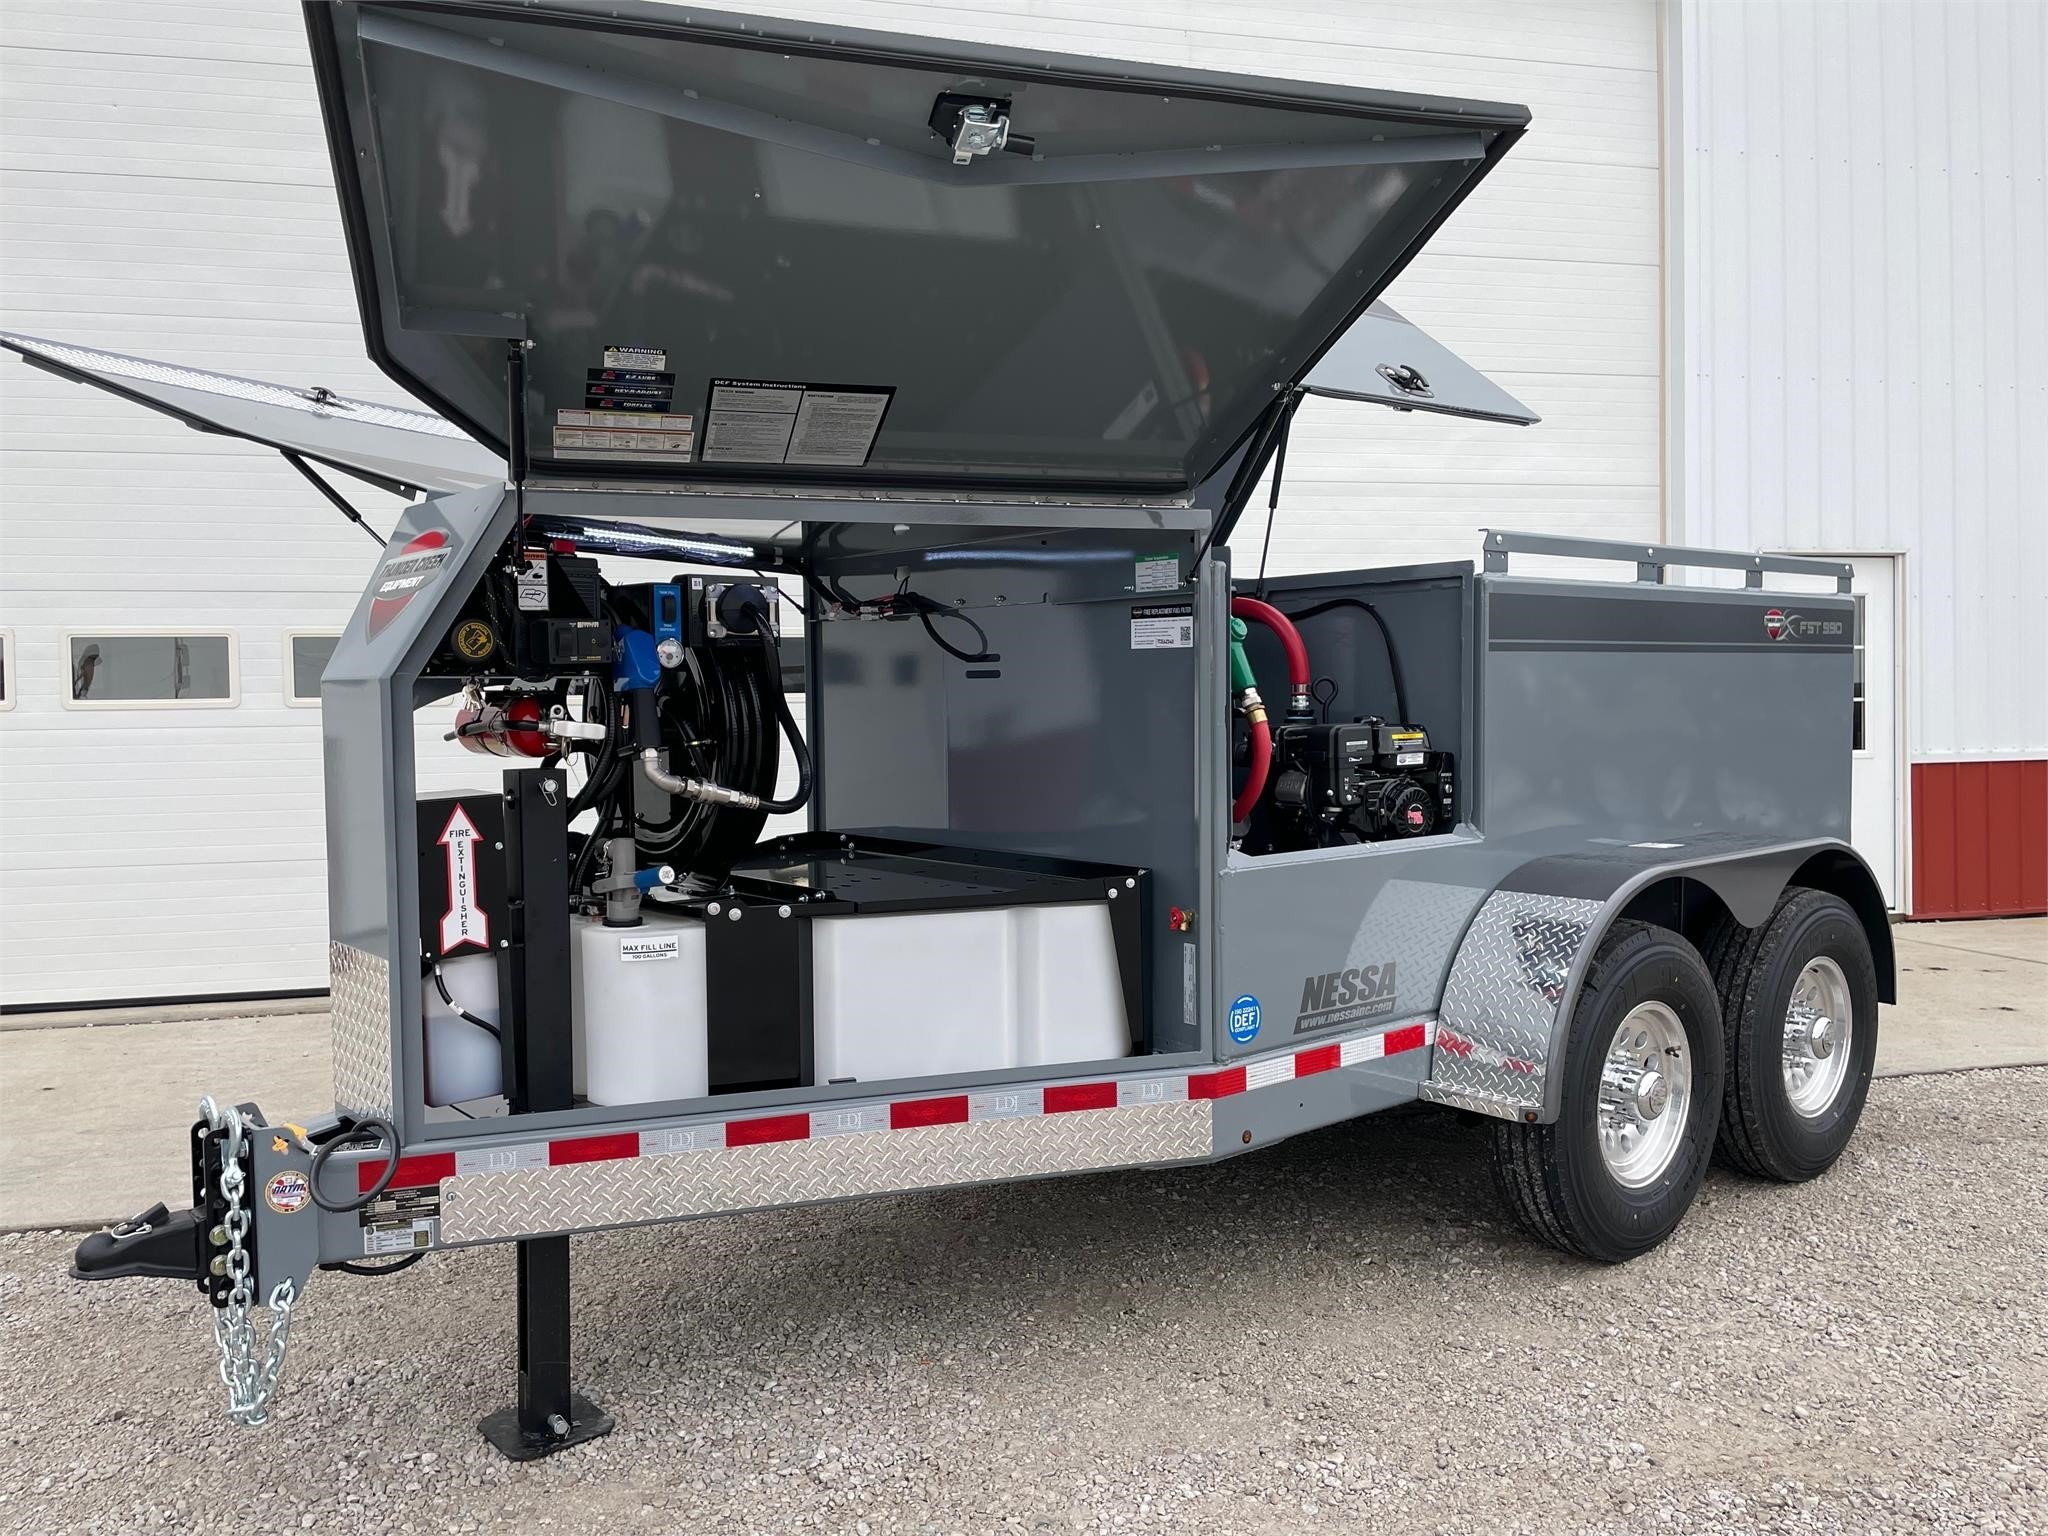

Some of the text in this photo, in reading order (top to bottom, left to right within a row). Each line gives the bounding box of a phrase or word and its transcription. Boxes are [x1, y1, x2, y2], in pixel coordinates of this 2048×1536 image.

[619, 346, 663, 355] WARNING
[379, 575, 424, 592] EQUIPMENT
[1800, 621, 1842, 634] FST 990
[449, 828, 471, 838] FIRE
[457, 840, 469, 936] EXTINGUISHER
[622, 942, 677, 952] MAX FILL LINE
[1300, 961, 1397, 1013] NESSA
[1234, 1012, 1256, 1028] DEF
[1300, 1001, 1393, 1029] www.nessainc.com
[1234, 1024, 1256, 1033] COMPLIANT
[1142, 1082, 1164, 1098] LDJ
[995, 1095, 1018, 1113] LDJ
[837, 1111, 863, 1129] LDJ
[668, 1131, 694, 1149] LDJ
[489, 1151, 517, 1169] LDJ
